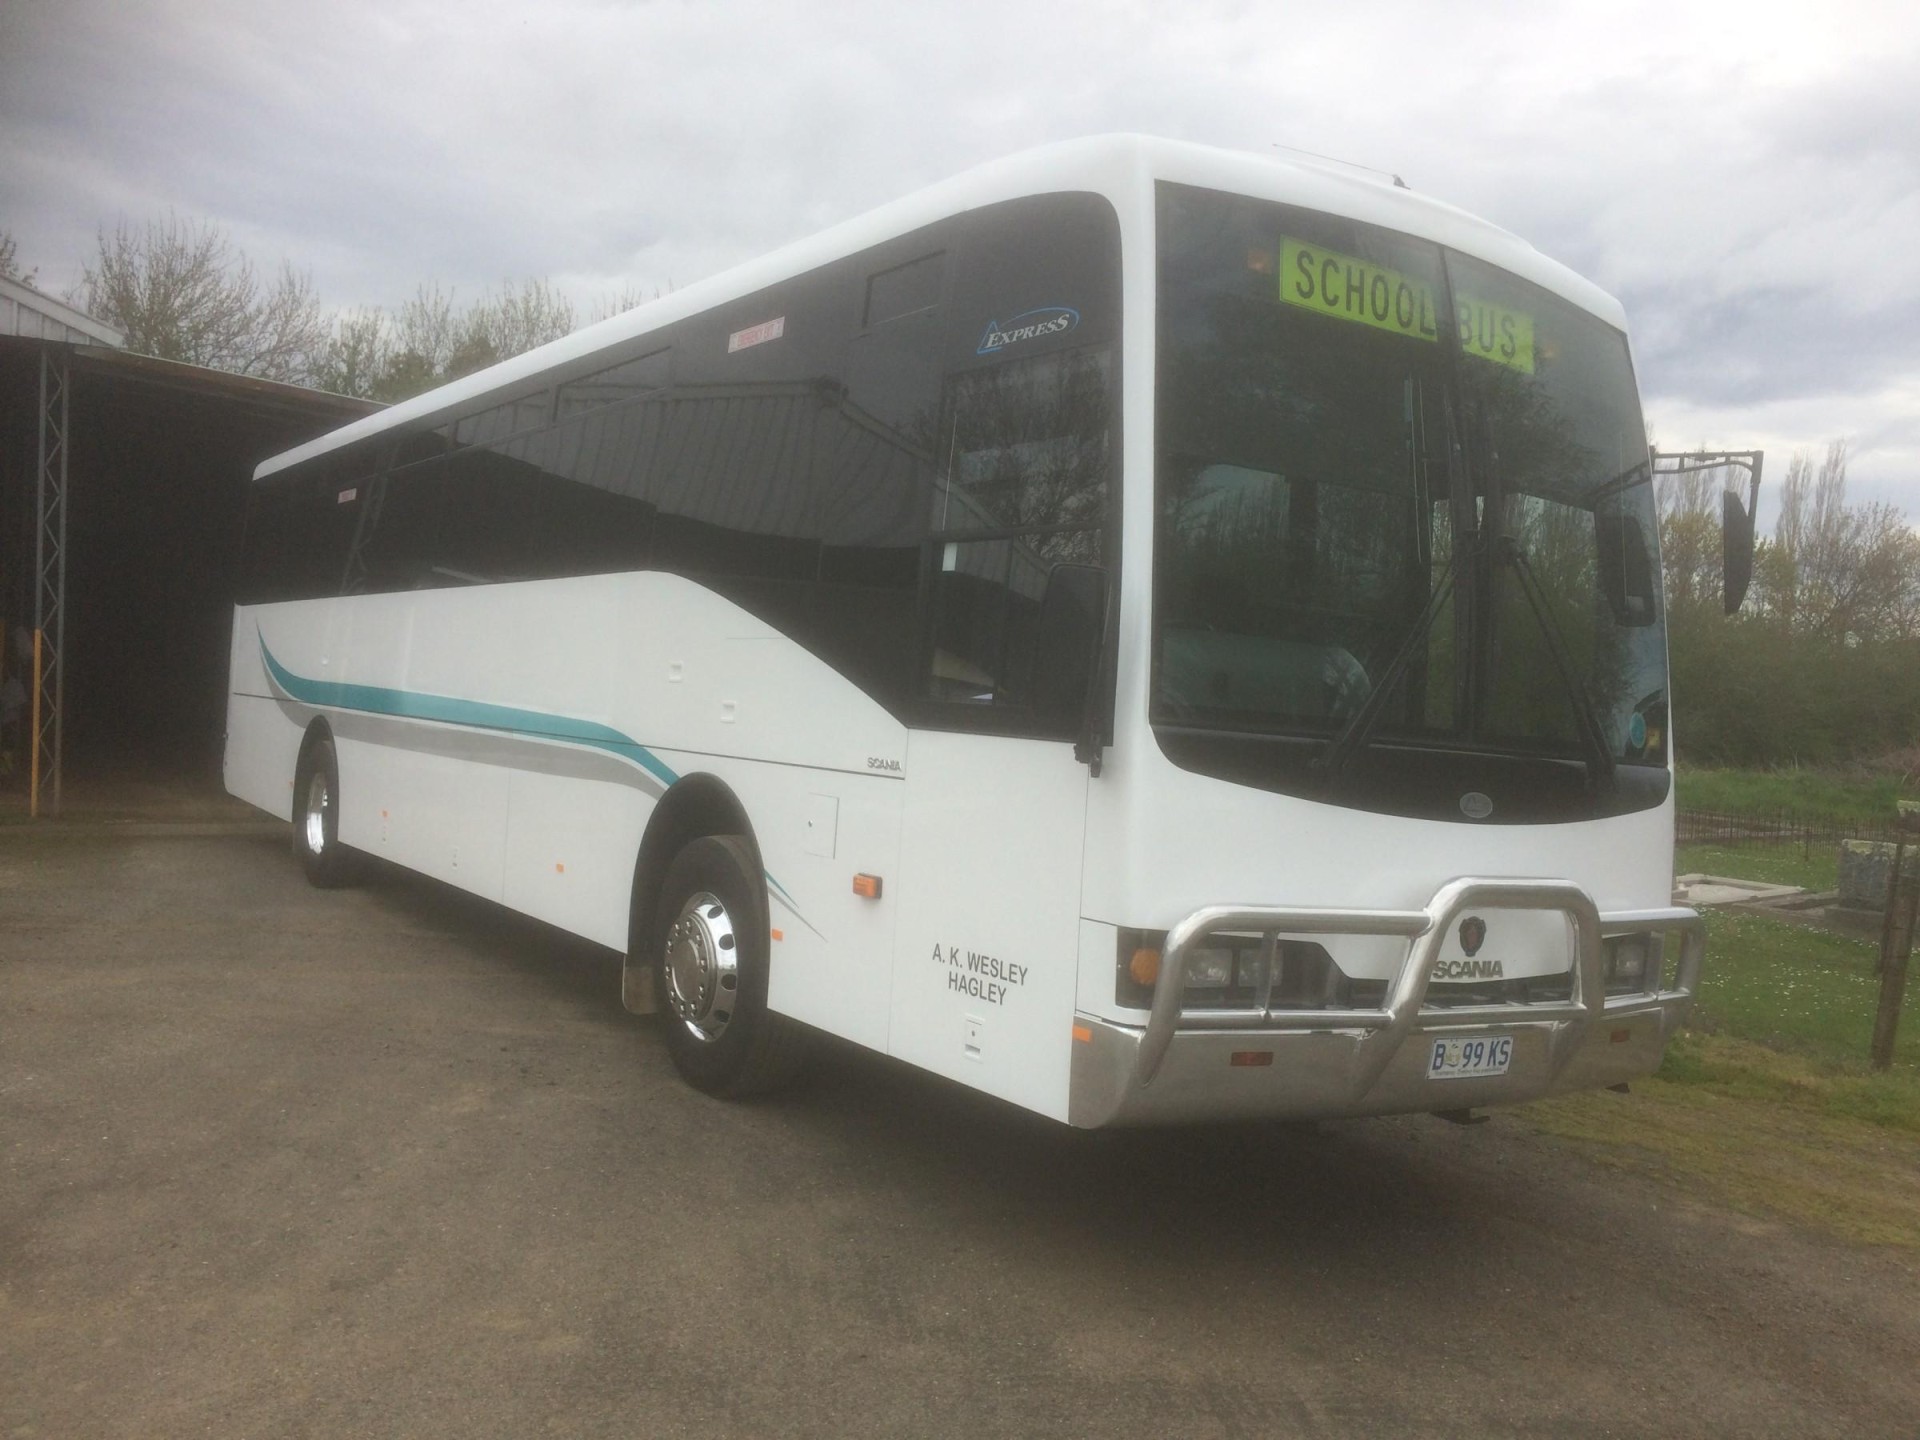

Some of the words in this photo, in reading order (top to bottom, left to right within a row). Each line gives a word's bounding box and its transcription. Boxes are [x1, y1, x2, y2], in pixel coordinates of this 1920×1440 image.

[1295, 249, 1436, 337] SCHOOL
[1459, 304, 1517, 358] BUS
[984, 313, 1070, 349] EXPRESS
[867, 756, 902, 772] SCANIA
[932, 942, 946, 964] A.
[949, 946, 963, 969] K.
[967, 950, 1028, 986] WESLEY
[1432, 960, 1503, 979] SCANIA
[948, 970, 1007, 1006] HAGLEY
